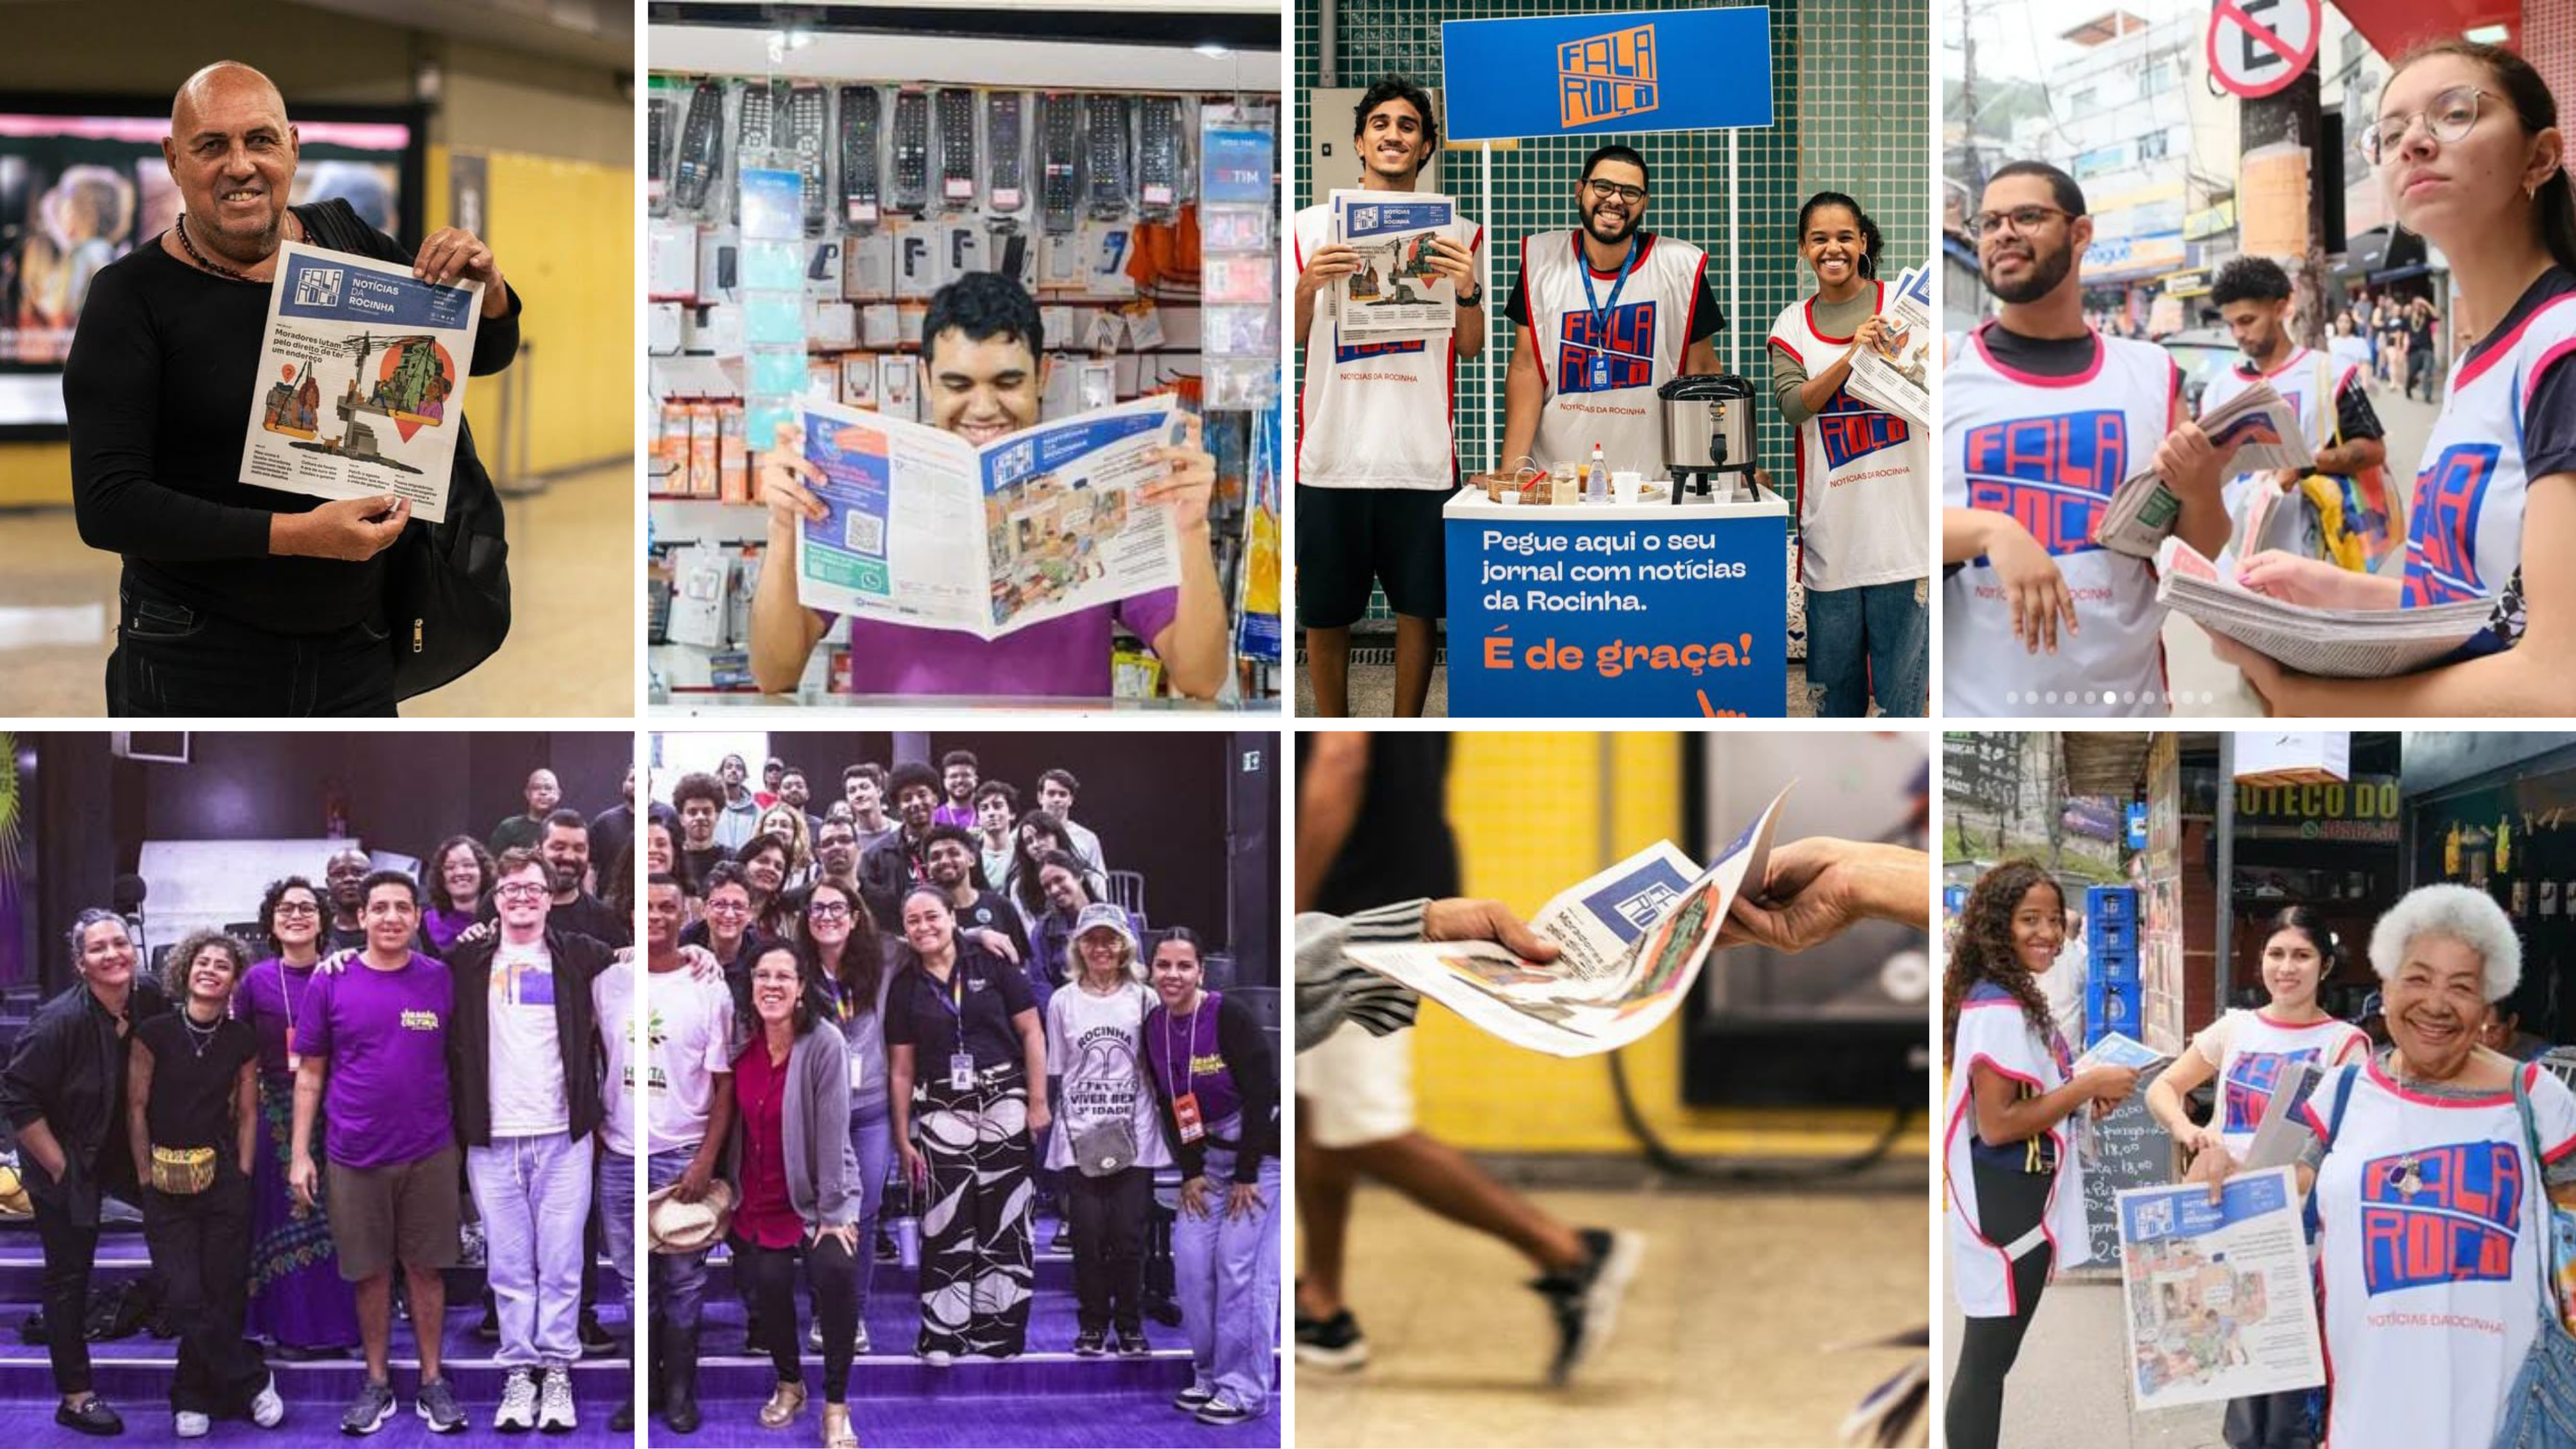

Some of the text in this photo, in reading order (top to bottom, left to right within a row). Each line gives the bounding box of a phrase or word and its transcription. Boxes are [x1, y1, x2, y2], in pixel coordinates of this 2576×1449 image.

[2241, 0, 2281, 72] E
[1562, 30, 1652, 79] FALA
[1235, 170, 1257, 184] TIM
[351, 289, 364, 297] DA
[353, 278, 399, 296] NOTÍCIAS
[349, 297, 394, 313] ROCINHA
[273, 338, 343, 359] pelo direito de ter
[275, 328, 342, 349] Moradores lutam
[272, 347, 323, 363] um endereço
[1609, 406, 1646, 416] ROCINHA
[1968, 414, 2124, 489] FALA
[1830, 472, 1867, 487] NOTÍCIAS
[1876, 466, 1910, 478] ROCINHA
[1483, 531, 1716, 556] Pegue aqui o seu
[1481, 559, 1747, 584] jornal com notícias
[1483, 590, 1647, 612] da Rocinha.
[1483, 624, 1753, 678] É de graça!
[1078, 1026, 1132, 1048] ROCINHA
[1071, 1094, 1107, 1104] VIVER
[1092, 1106, 1131, 1115] IDADE
[2366, 1147, 2520, 1227] FALA
